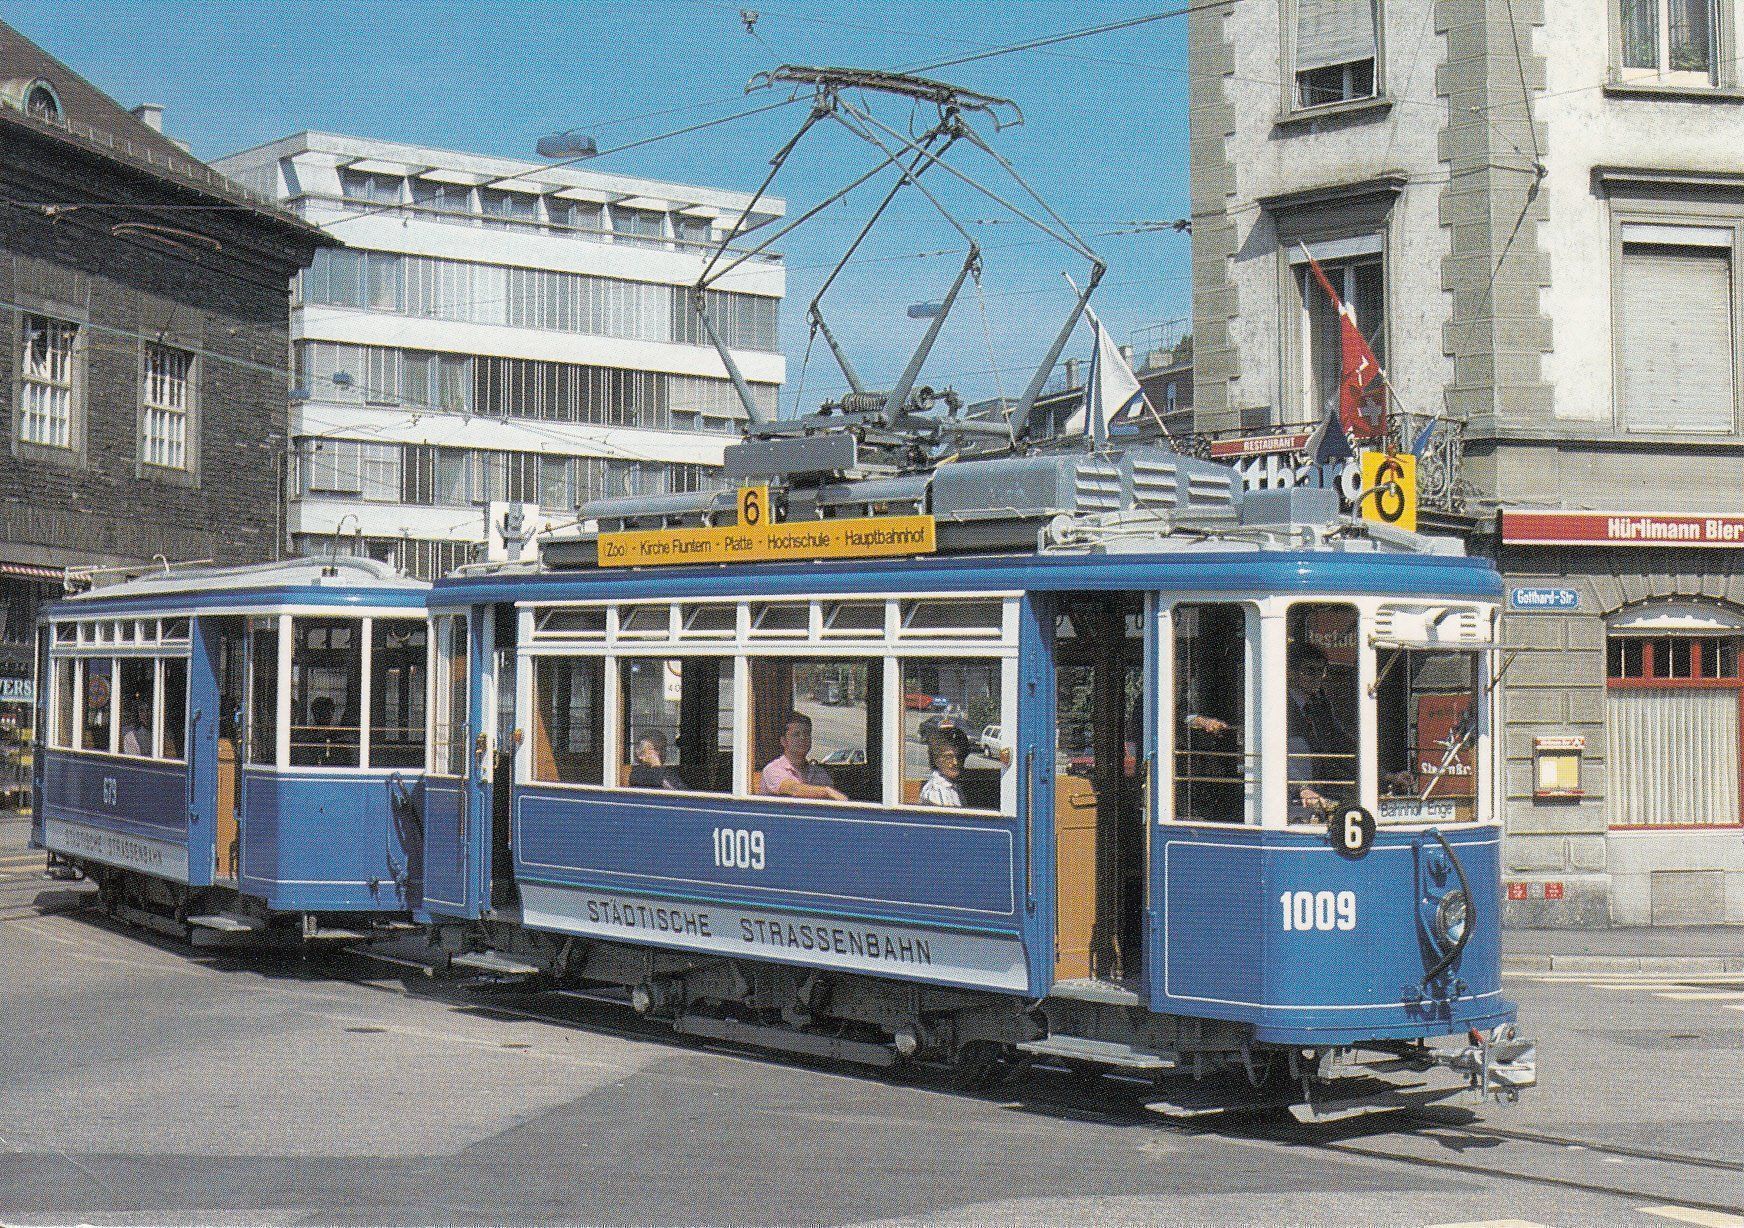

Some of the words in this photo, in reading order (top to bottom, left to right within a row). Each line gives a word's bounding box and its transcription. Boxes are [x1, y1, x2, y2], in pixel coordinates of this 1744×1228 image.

[1243, 437, 1295, 452] RESTAURANT
[743, 490, 760, 525] 6
[1374, 459, 1405, 523] 6
[640, 539, 670, 556] Kirche
[672, 538, 712, 554] Fluntern
[724, 535, 753, 551] Platte
[767, 533, 831, 549] Hochschule
[845, 526, 925, 548] Hauptbahnhof
[1607, 517, 1701, 539] Hürlimann
[1705, 519, 1744, 540] Bier
[1380, 800, 1422, 817] Bahnhof
[1426, 800, 1453, 818] Enge
[1344, 810, 1363, 848] 6
[712, 827, 766, 870] 1009
[1279, 890, 1357, 932] 1009
[587, 898, 712, 938] STÄDTISCHE
[739, 917, 933, 966] STRASSENBAHN
